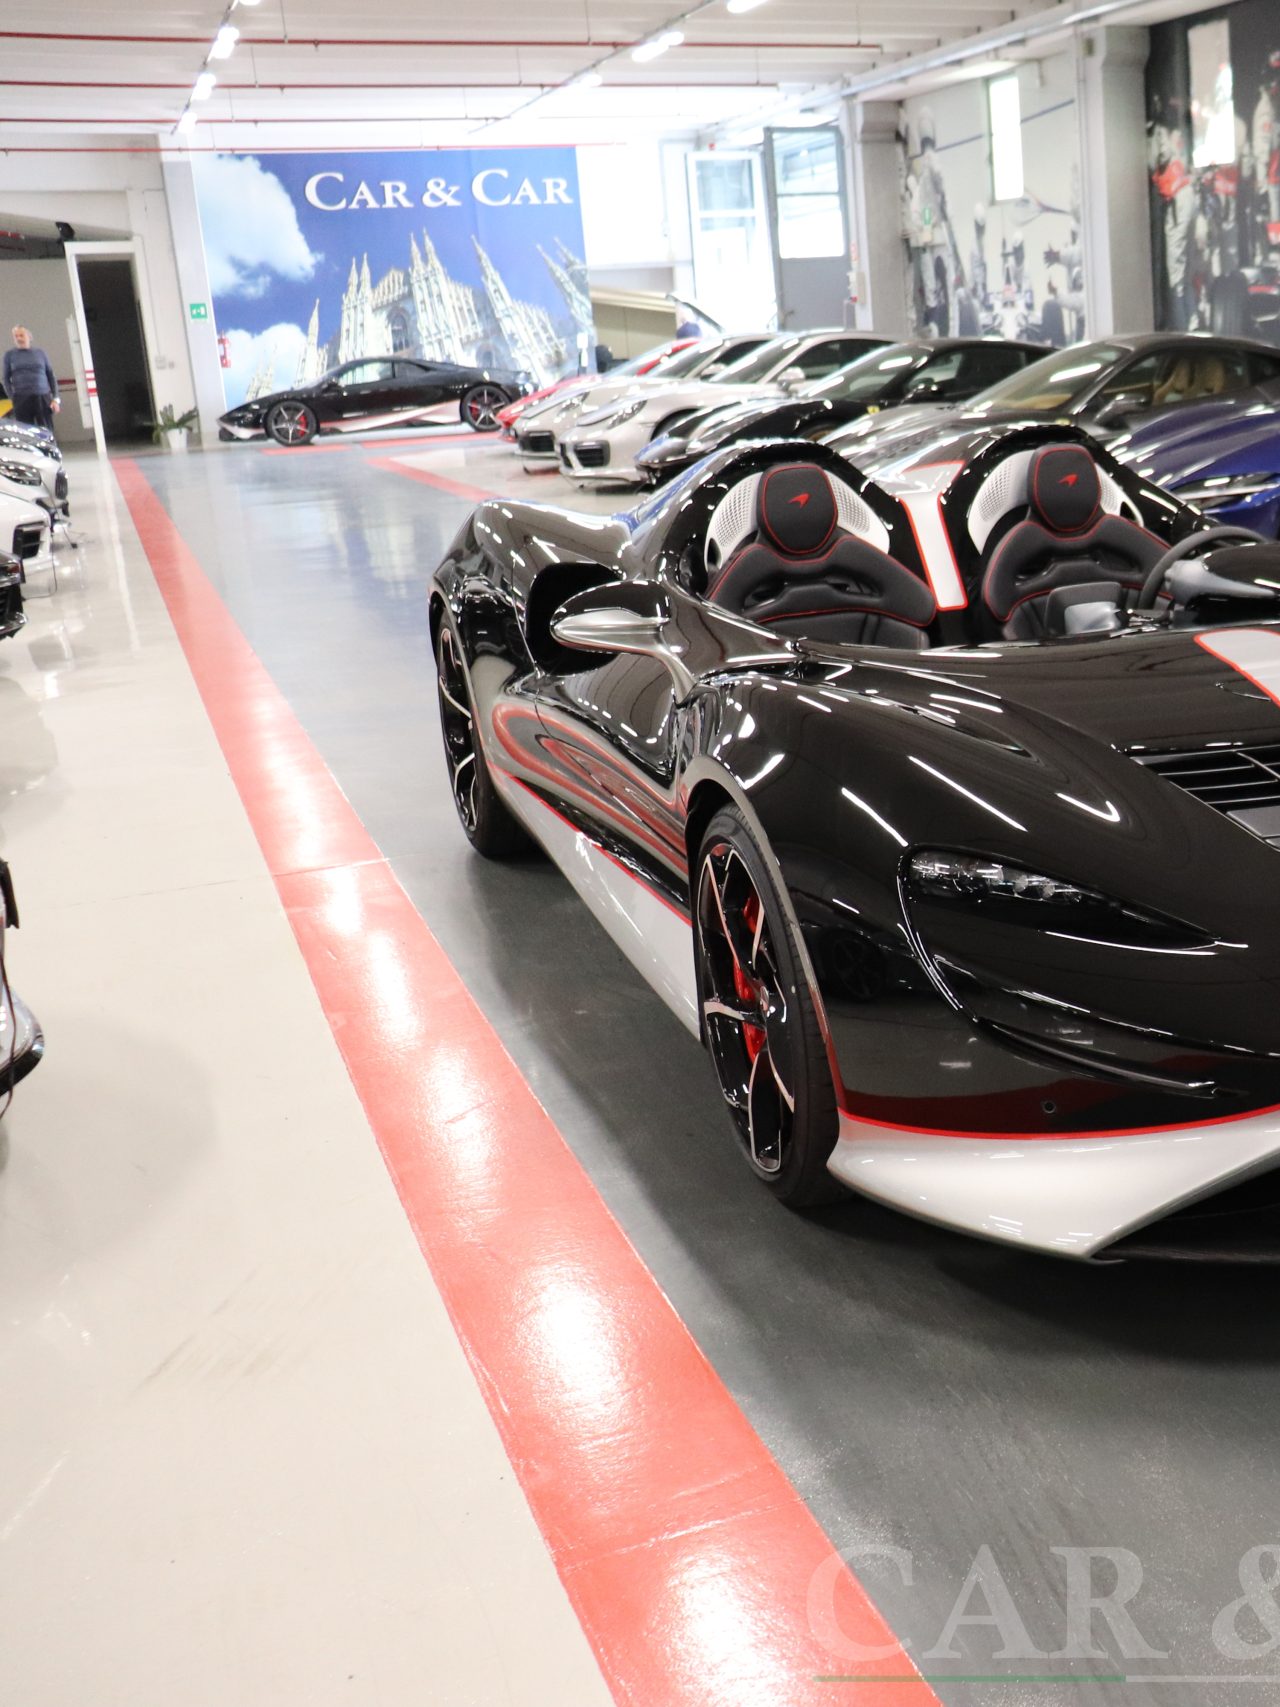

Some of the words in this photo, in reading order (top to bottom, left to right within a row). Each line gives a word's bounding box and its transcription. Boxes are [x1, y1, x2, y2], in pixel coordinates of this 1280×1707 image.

[304, 171, 414, 211] CAR
[421, 177, 462, 208] &
[471, 168, 574, 206] CAR
